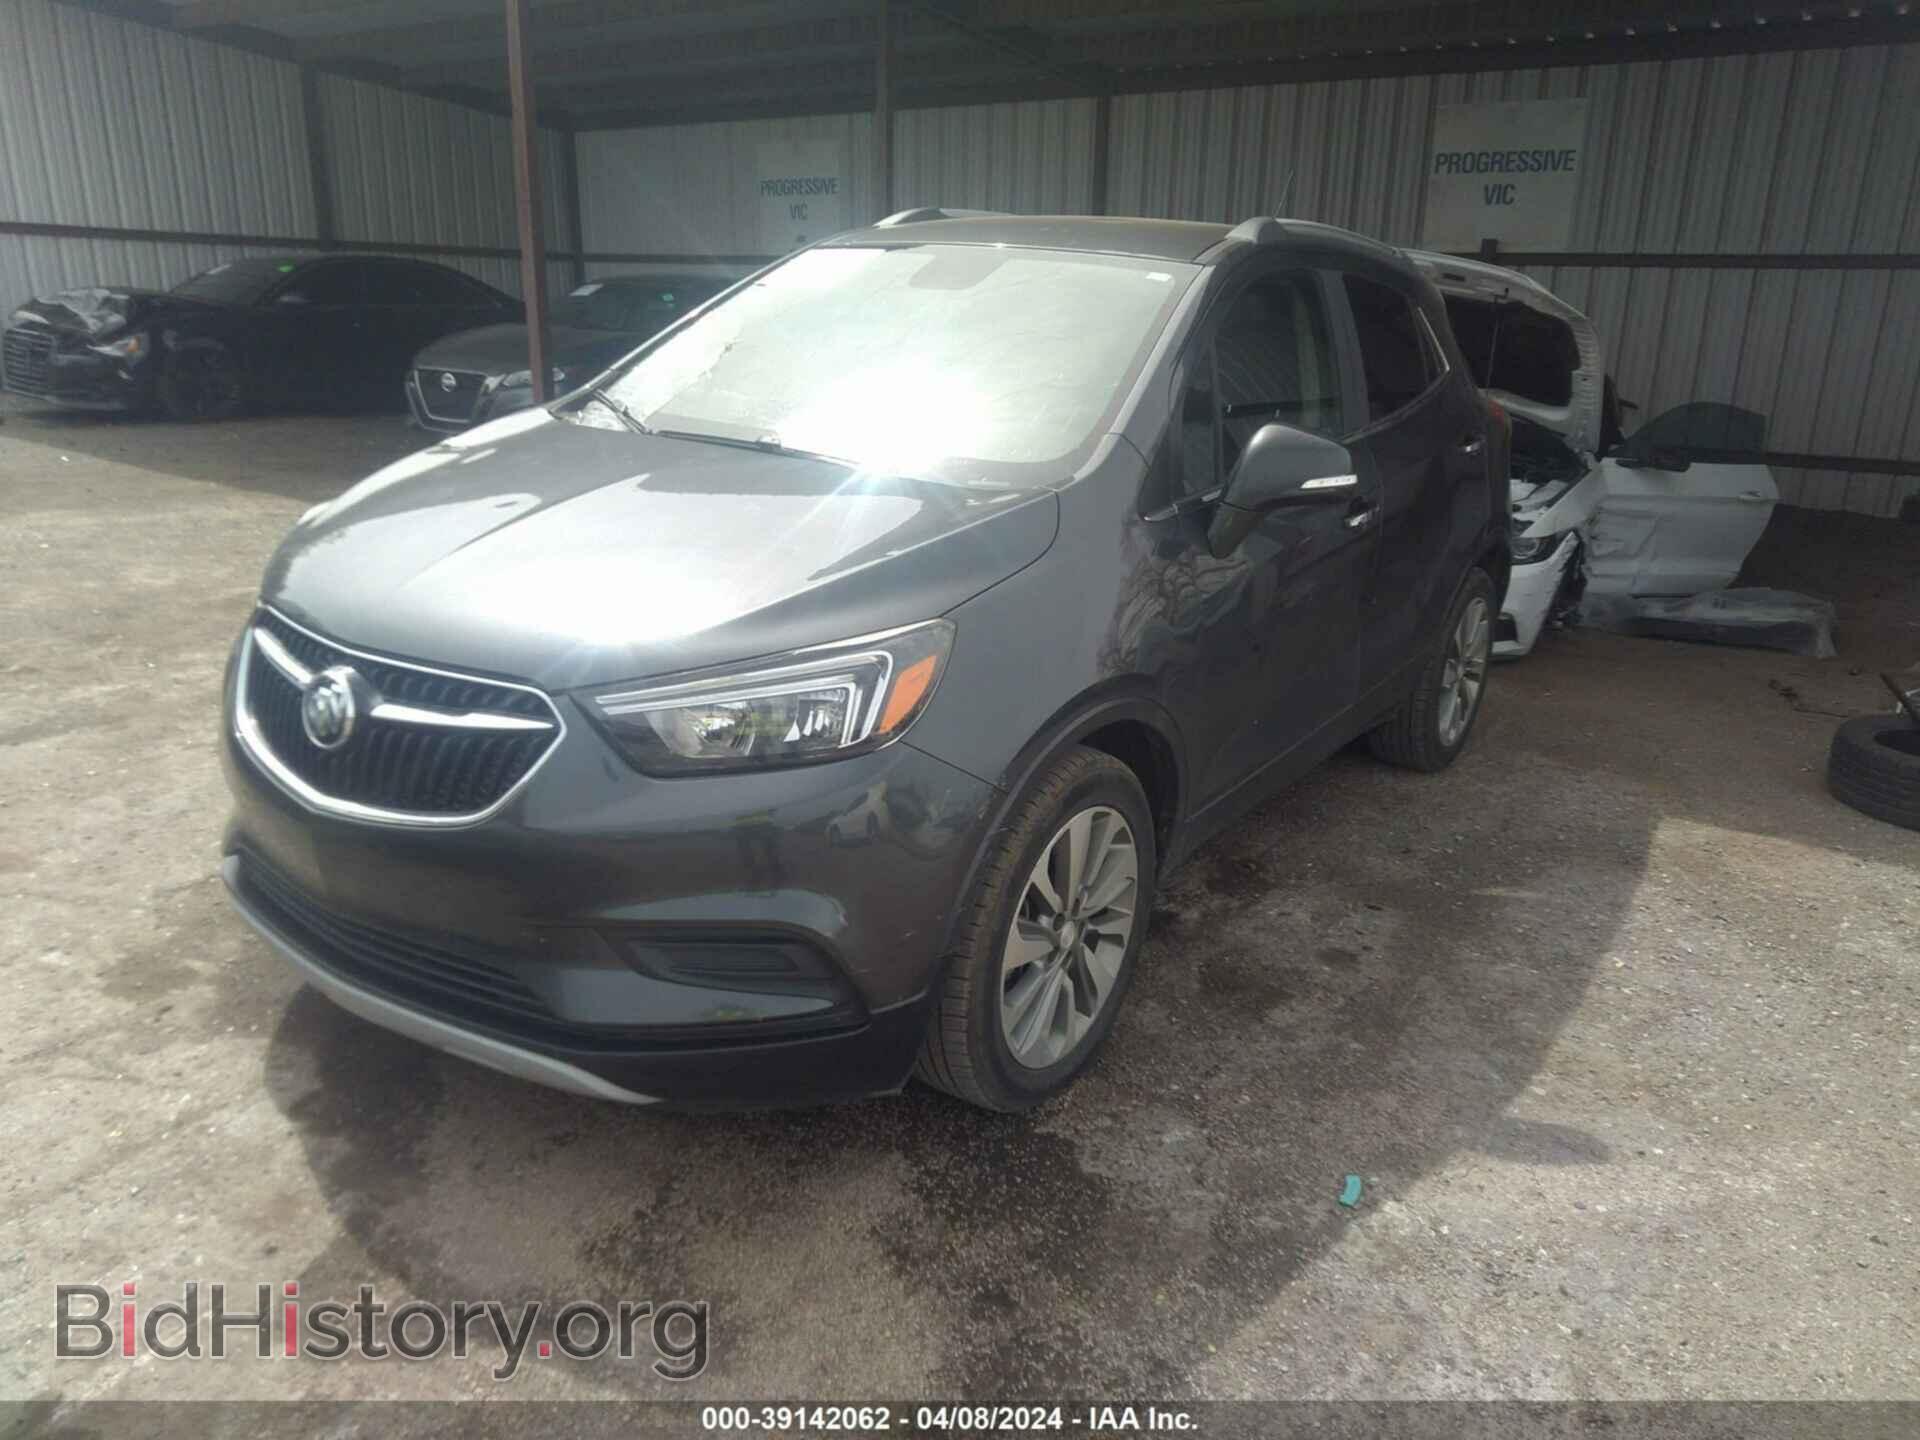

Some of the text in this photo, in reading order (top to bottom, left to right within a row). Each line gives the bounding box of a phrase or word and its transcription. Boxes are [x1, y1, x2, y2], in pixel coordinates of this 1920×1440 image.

[1435, 150, 1576, 174] PROGRESSIVE
[760, 178, 838, 196] PROGRESSIVE
[1484, 184, 1516, 205] VIC
[790, 203, 808, 219] VIC
